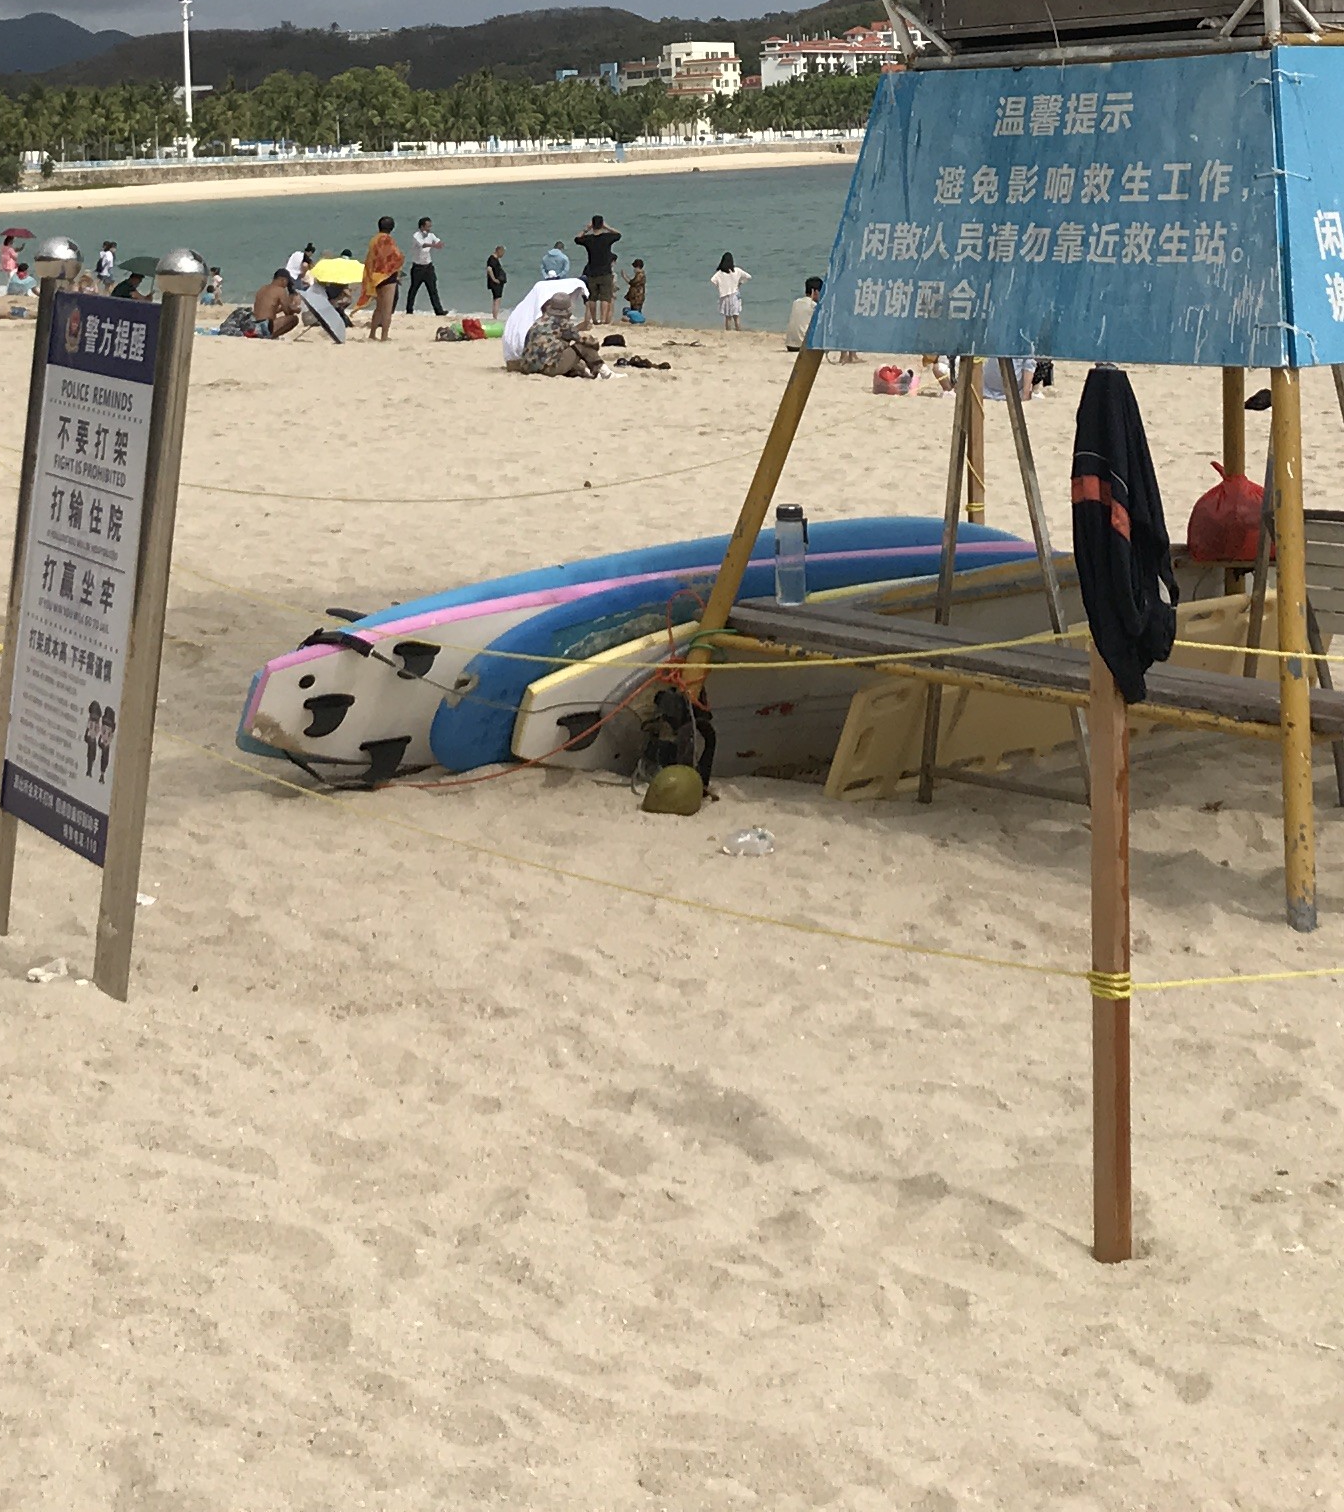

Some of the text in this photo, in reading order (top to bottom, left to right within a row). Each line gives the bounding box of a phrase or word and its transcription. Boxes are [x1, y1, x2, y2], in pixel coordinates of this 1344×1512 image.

[993, 92, 1134, 137] 温馨提示
[934, 159, 1249, 204] 避免影响救生工作，
[859, 222, 1244, 265] 闲散人员请勿靠近救生站。
[84, 315, 147, 362] 警方提醒
[61, 379, 134, 412] POLICE REMINDS
[57, 416, 129, 466] 不要打架
[54, 454, 74, 471] FIGHT
[83, 462, 126, 487] PROHIBITED
[51, 485, 123, 542] 打输住院
[42, 554, 115, 614] 打赢坐牢
